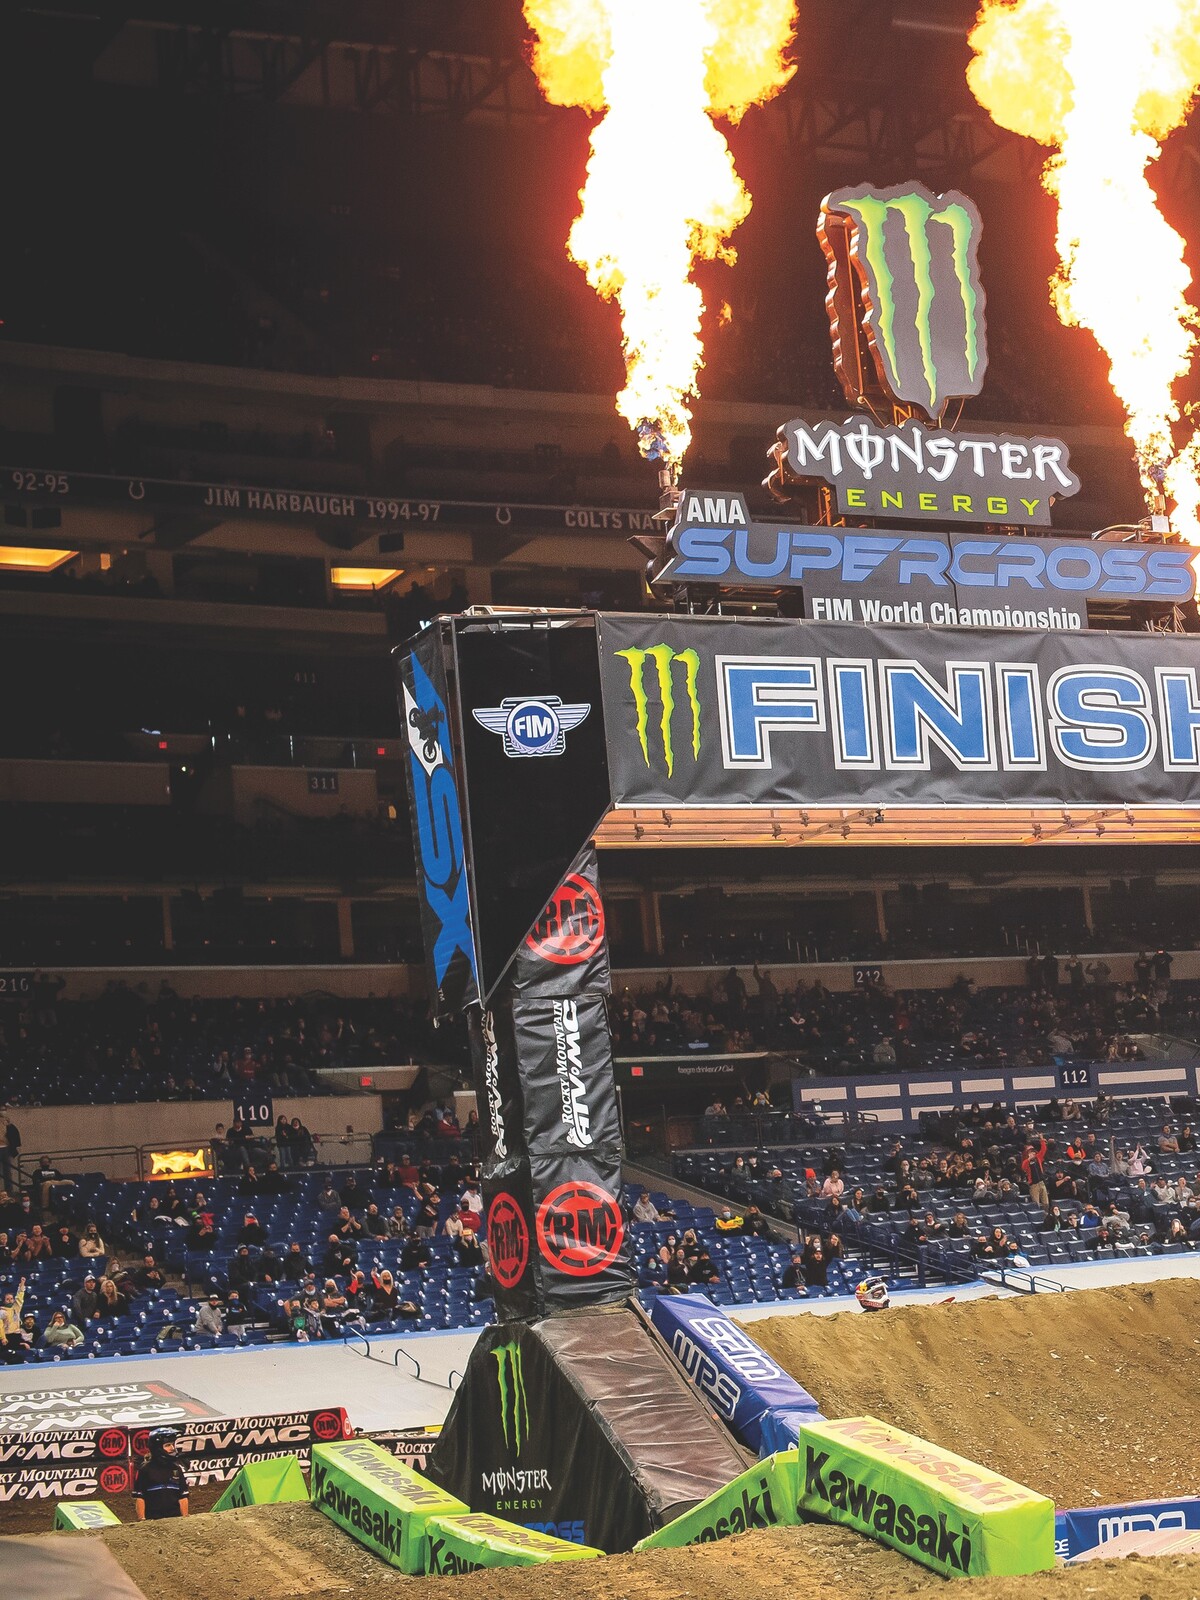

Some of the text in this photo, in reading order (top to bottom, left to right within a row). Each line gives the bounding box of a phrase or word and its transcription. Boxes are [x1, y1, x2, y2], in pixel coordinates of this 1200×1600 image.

[793, 424, 1073, 489] MONSTER
[12, 471, 69, 494] 92-95
[204, 487, 441, 521] JIM HARBAUGH 1994-97
[686, 497, 746, 525] AMA
[846, 487, 1041, 517] ENERGY
[564, 510, 622, 529] COLTS
[812, 596, 1081, 630] FIM World Championship
[515, 715, 552, 738] FIM
[311, 777, 337, 790] 311
[480, 1012, 498, 1137] ROCKY MOUNTAIN
[552, 1000, 574, 1124] ROCKY MOUNTAIN
[1063, 1069, 1088, 1084] 112
[237, 1104, 269, 1121] 110
[672, 1329, 741, 1421] WPS
[18, 1430, 97, 1444] MOUNTAIN
[185, 1413, 309, 1436] ROCKY MOUNTAIN
[395, 1441, 435, 1454] ROCKY
[17, 1467, 97, 1483] MOUNTAIN
[188, 1458, 232, 1472] ROCKY
[331, 1442, 445, 1506] Kawasaki
[826, 1419, 1029, 1505] Kawasaki
[482, 1466, 552, 1495] MONSTER
[314, 1462, 403, 1557] Kawasaki
[497, 1500, 543, 1511] ENERGY
[805, 1445, 973, 1574] Kawasaki
